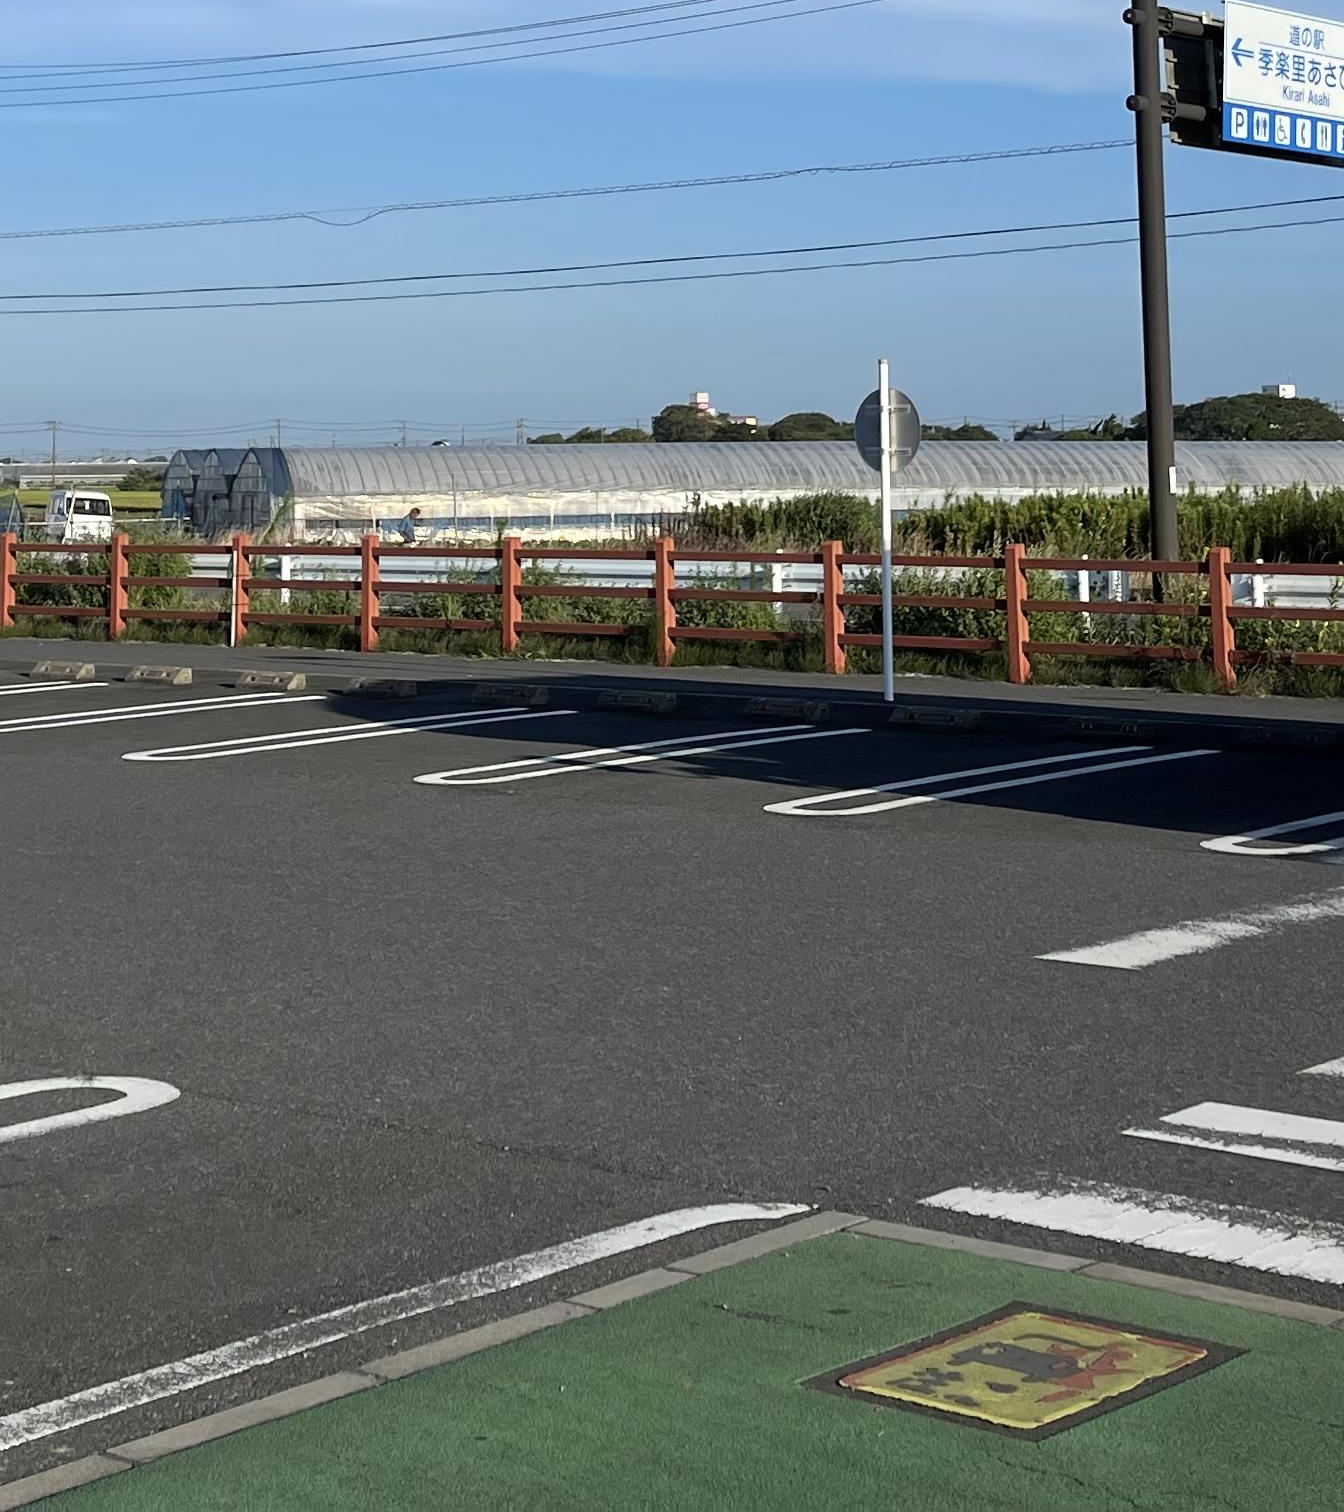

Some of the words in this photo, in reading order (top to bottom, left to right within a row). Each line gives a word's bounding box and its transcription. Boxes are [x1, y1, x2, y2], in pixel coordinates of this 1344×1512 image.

[1289, 25, 1325, 50] 道の駅
[1282, 85, 1305, 103] Kirari
[1308, 90, 1330, 107] Asahi
[1235, 111, 1244, 135] P
